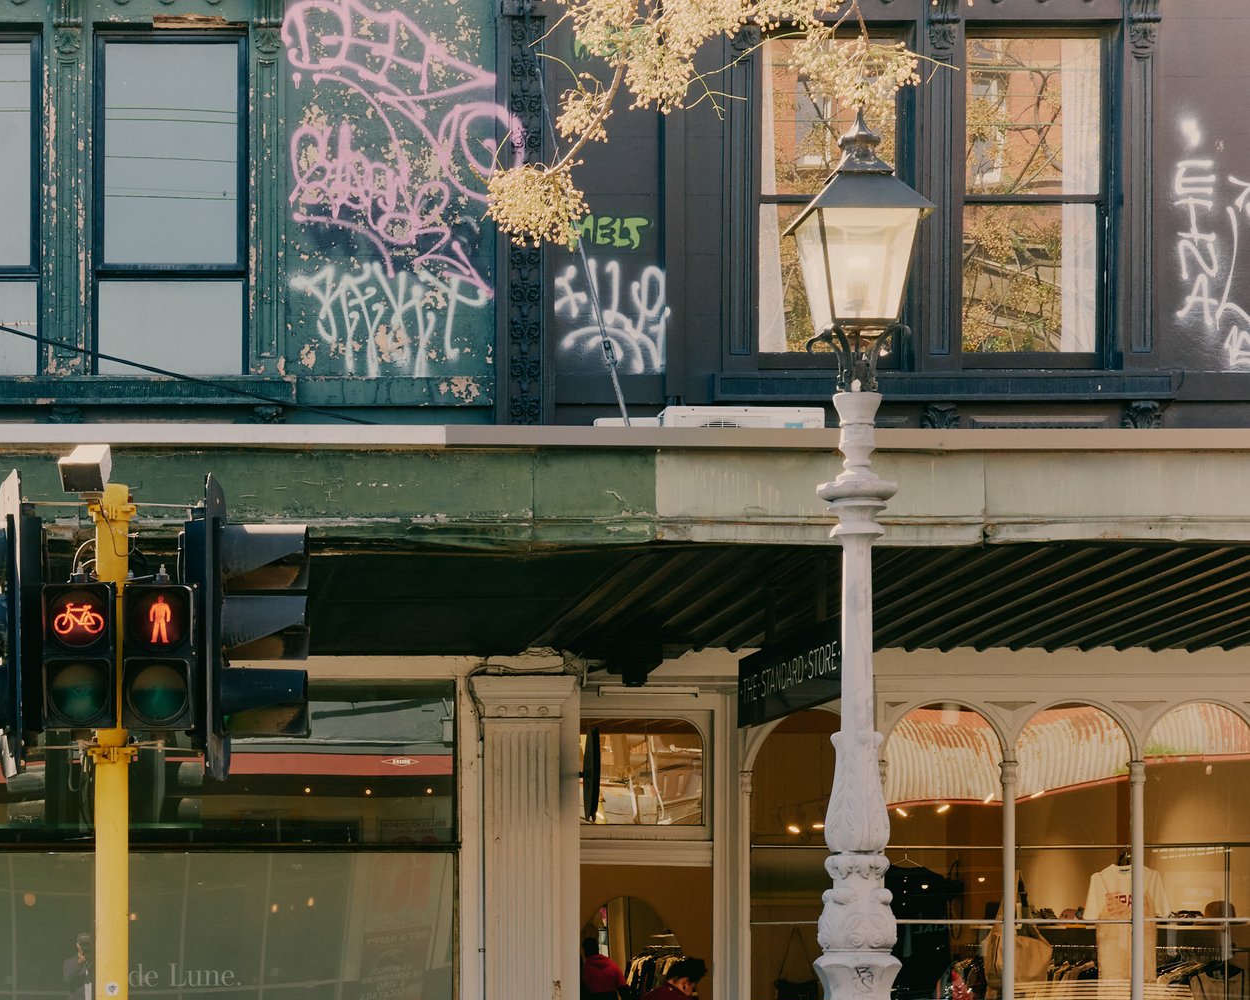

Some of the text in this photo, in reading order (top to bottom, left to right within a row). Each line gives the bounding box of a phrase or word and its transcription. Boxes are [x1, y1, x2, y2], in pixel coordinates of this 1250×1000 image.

[743, 640, 838, 704] THE STANDARD STORE
[128, 962, 242, 987] de Lune.
